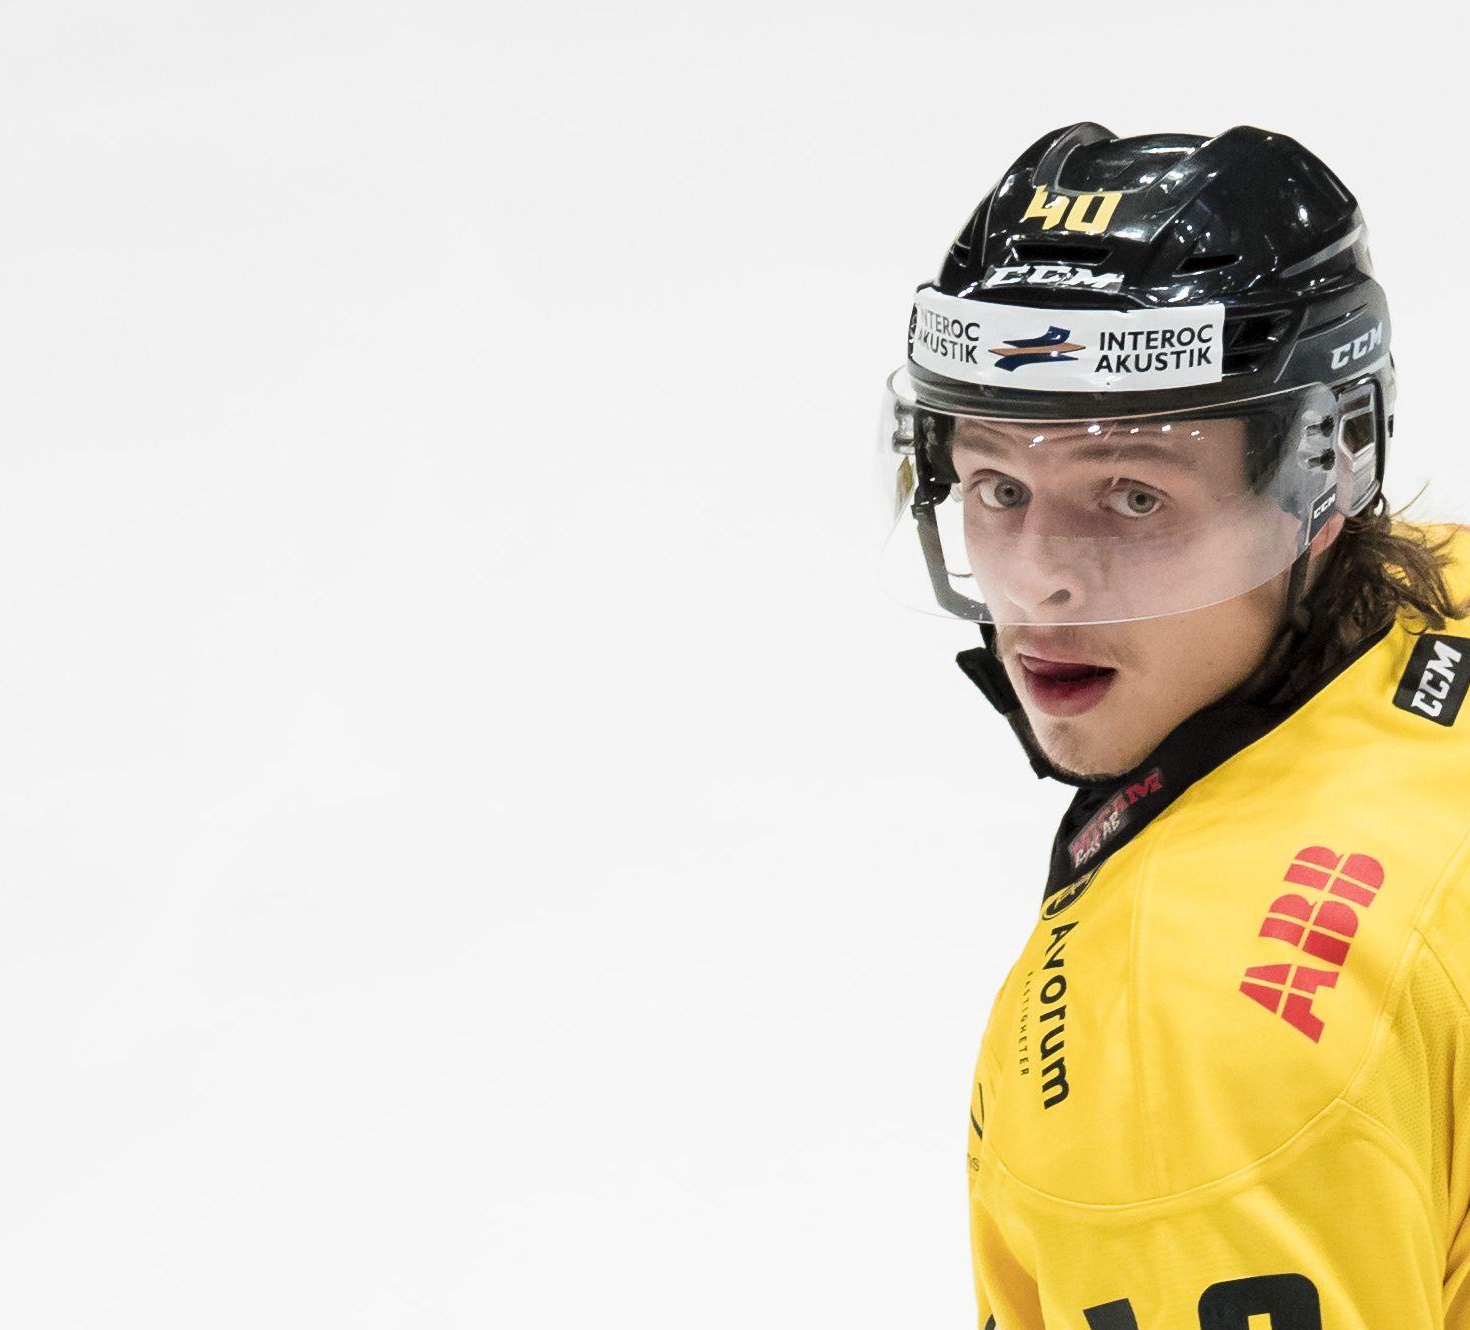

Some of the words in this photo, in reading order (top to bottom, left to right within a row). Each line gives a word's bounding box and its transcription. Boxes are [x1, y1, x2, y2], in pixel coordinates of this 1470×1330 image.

[1024, 184, 1122, 235] 40
[985, 265, 1124, 289] CCM
[917, 308, 981, 342] NTEROC
[1099, 324, 1214, 352] INTEROC
[1331, 322, 1383, 370] CCM
[1094, 346, 1213, 374] AKUSTIK
[1411, 640, 1462, 718] CCM
[1239, 846, 1385, 1045] ABB
[1040, 921, 1080, 1110] Avorum
